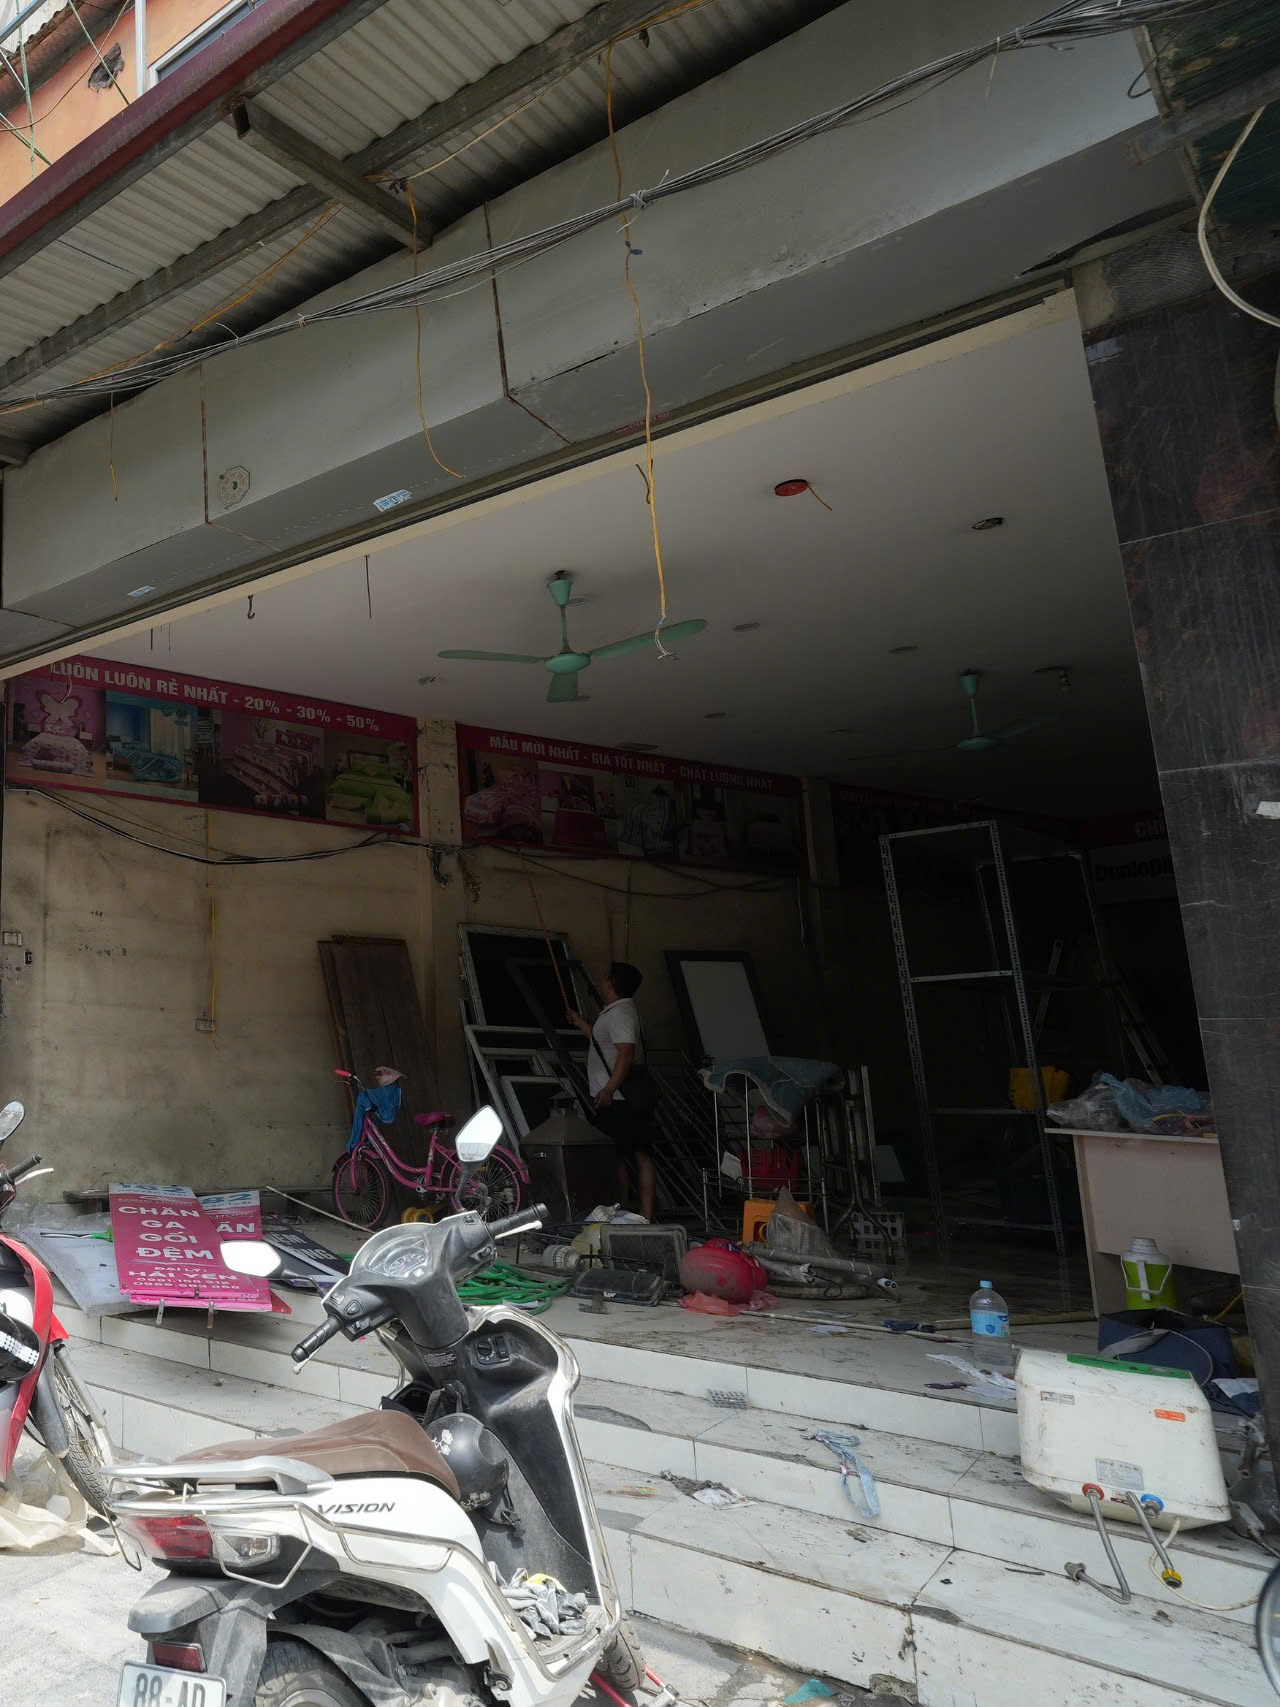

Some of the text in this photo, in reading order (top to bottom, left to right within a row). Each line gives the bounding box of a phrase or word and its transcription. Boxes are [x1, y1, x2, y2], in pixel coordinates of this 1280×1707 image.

[104, 670, 152, 692] LUÔN
[156, 677, 180, 697] RẺ
[183, 684, 229, 706] NHẤT
[244, 695, 281, 714] 20%
[296, 705, 331, 723] 30%
[346, 714, 380, 732] 50%
[118, 1206, 201, 1218] CHĂN
[141, 1220, 186, 1230] GA
[139, 1231, 198, 1244] GỐI
[136, 1247, 214, 1261] ĐỆM
[317, 1501, 396, 1515] VISION
